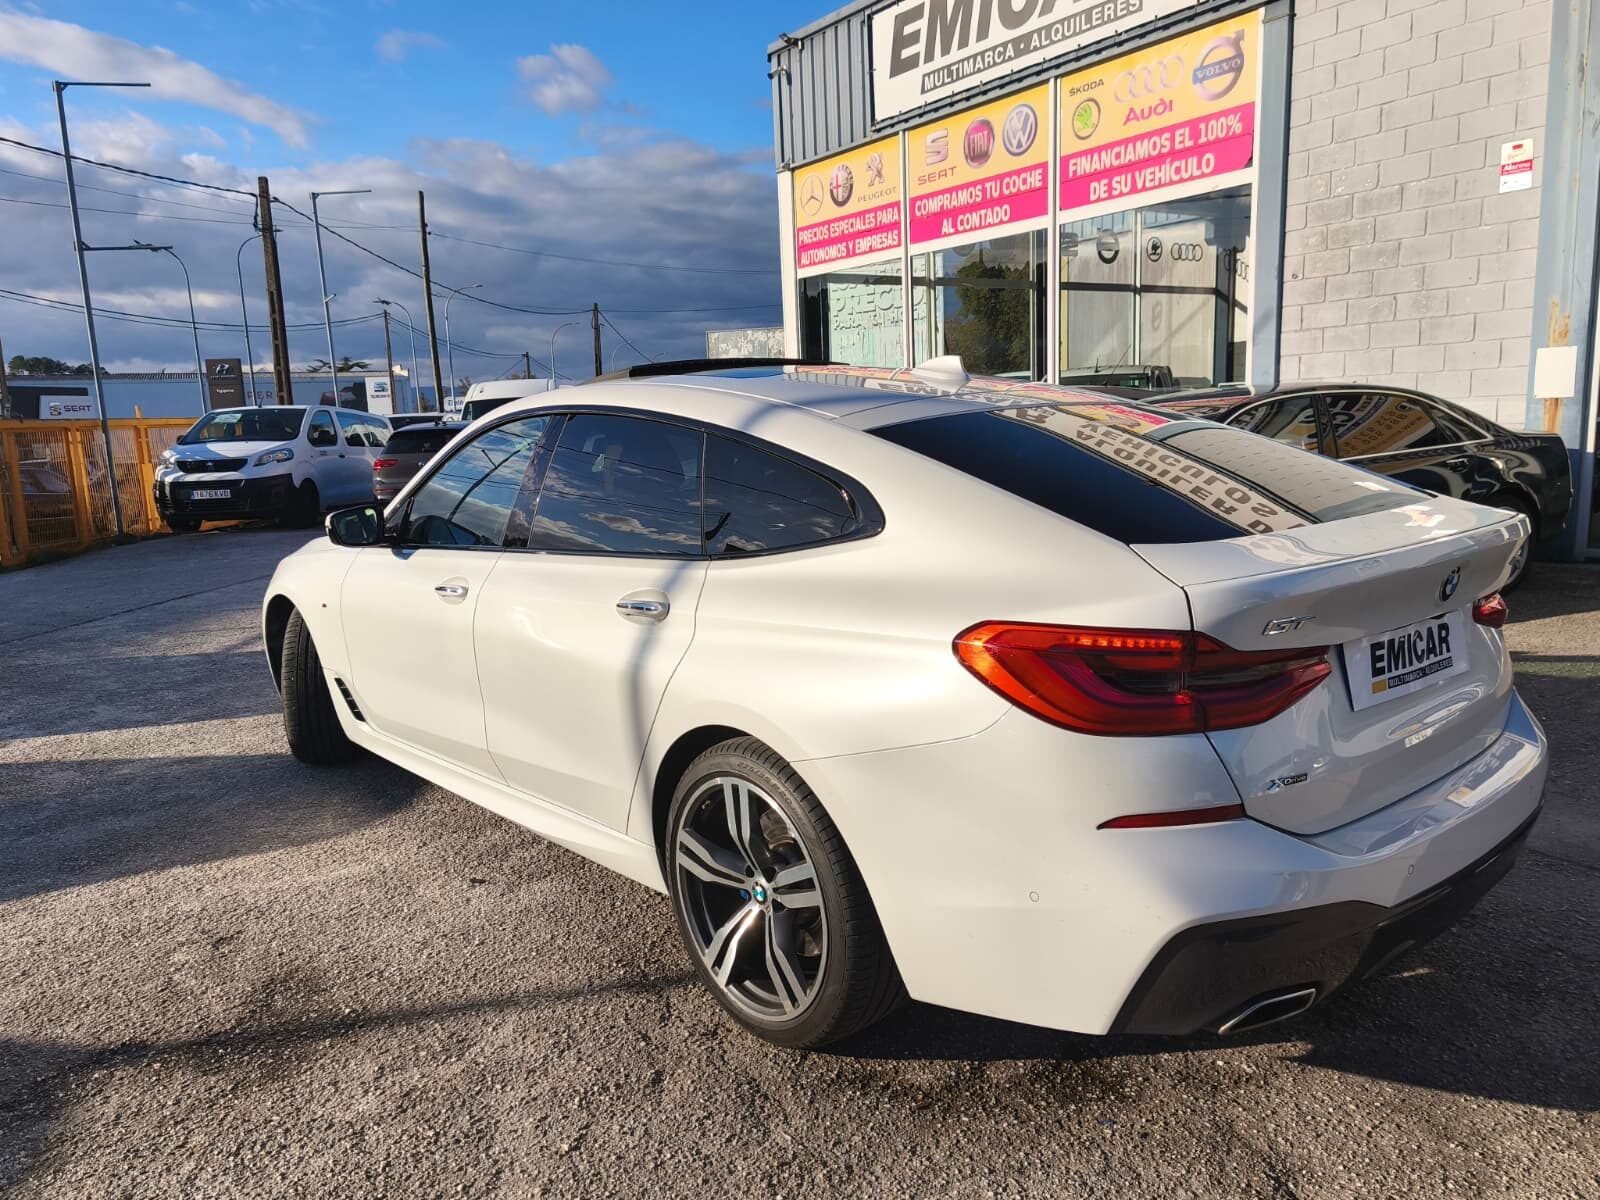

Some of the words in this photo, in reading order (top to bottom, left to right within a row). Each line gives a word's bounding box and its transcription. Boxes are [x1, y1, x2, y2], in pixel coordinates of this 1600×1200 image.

[924, 44, 1015, 91] MULTIMARCA
[1030, 0, 1140, 49] ALQUILERES
[1195, 59, 1242, 80] VOLVO
[1069, 78, 1105, 97] ŠKODA
[970, 131, 988, 160] FIAT
[1069, 132, 1171, 178] FINANCIAMOS
[1175, 129, 1194, 149] EL
[1198, 112, 1243, 144] 100%
[917, 166, 957, 186] SEAT
[1090, 177, 1109, 201] DE
[1112, 169, 1132, 194] SU
[1135, 152, 1215, 187] VEHÍCULO
[858, 187, 896, 203] PEUGEOT
[915, 184, 982, 217] COMPRAMOS
[985, 179, 1000, 199] TU
[1003, 168, 1043, 195] COCHE
[799, 224, 829, 245] PRECIOS
[830, 213, 875, 238] ESPECIALES
[877, 206, 899, 226] PARA
[941, 218, 955, 235] AL
[957, 203, 1010, 230] CONTADO
[801, 243, 847, 266] AUTONOMOS
[848, 241, 856, 255] Y
[856, 229, 899, 253] EMPRESAS
[63, 404, 93, 412] SEAT
[1262, 616, 1317, 636] GT
[1370, 623, 1451, 678] EMICAR
